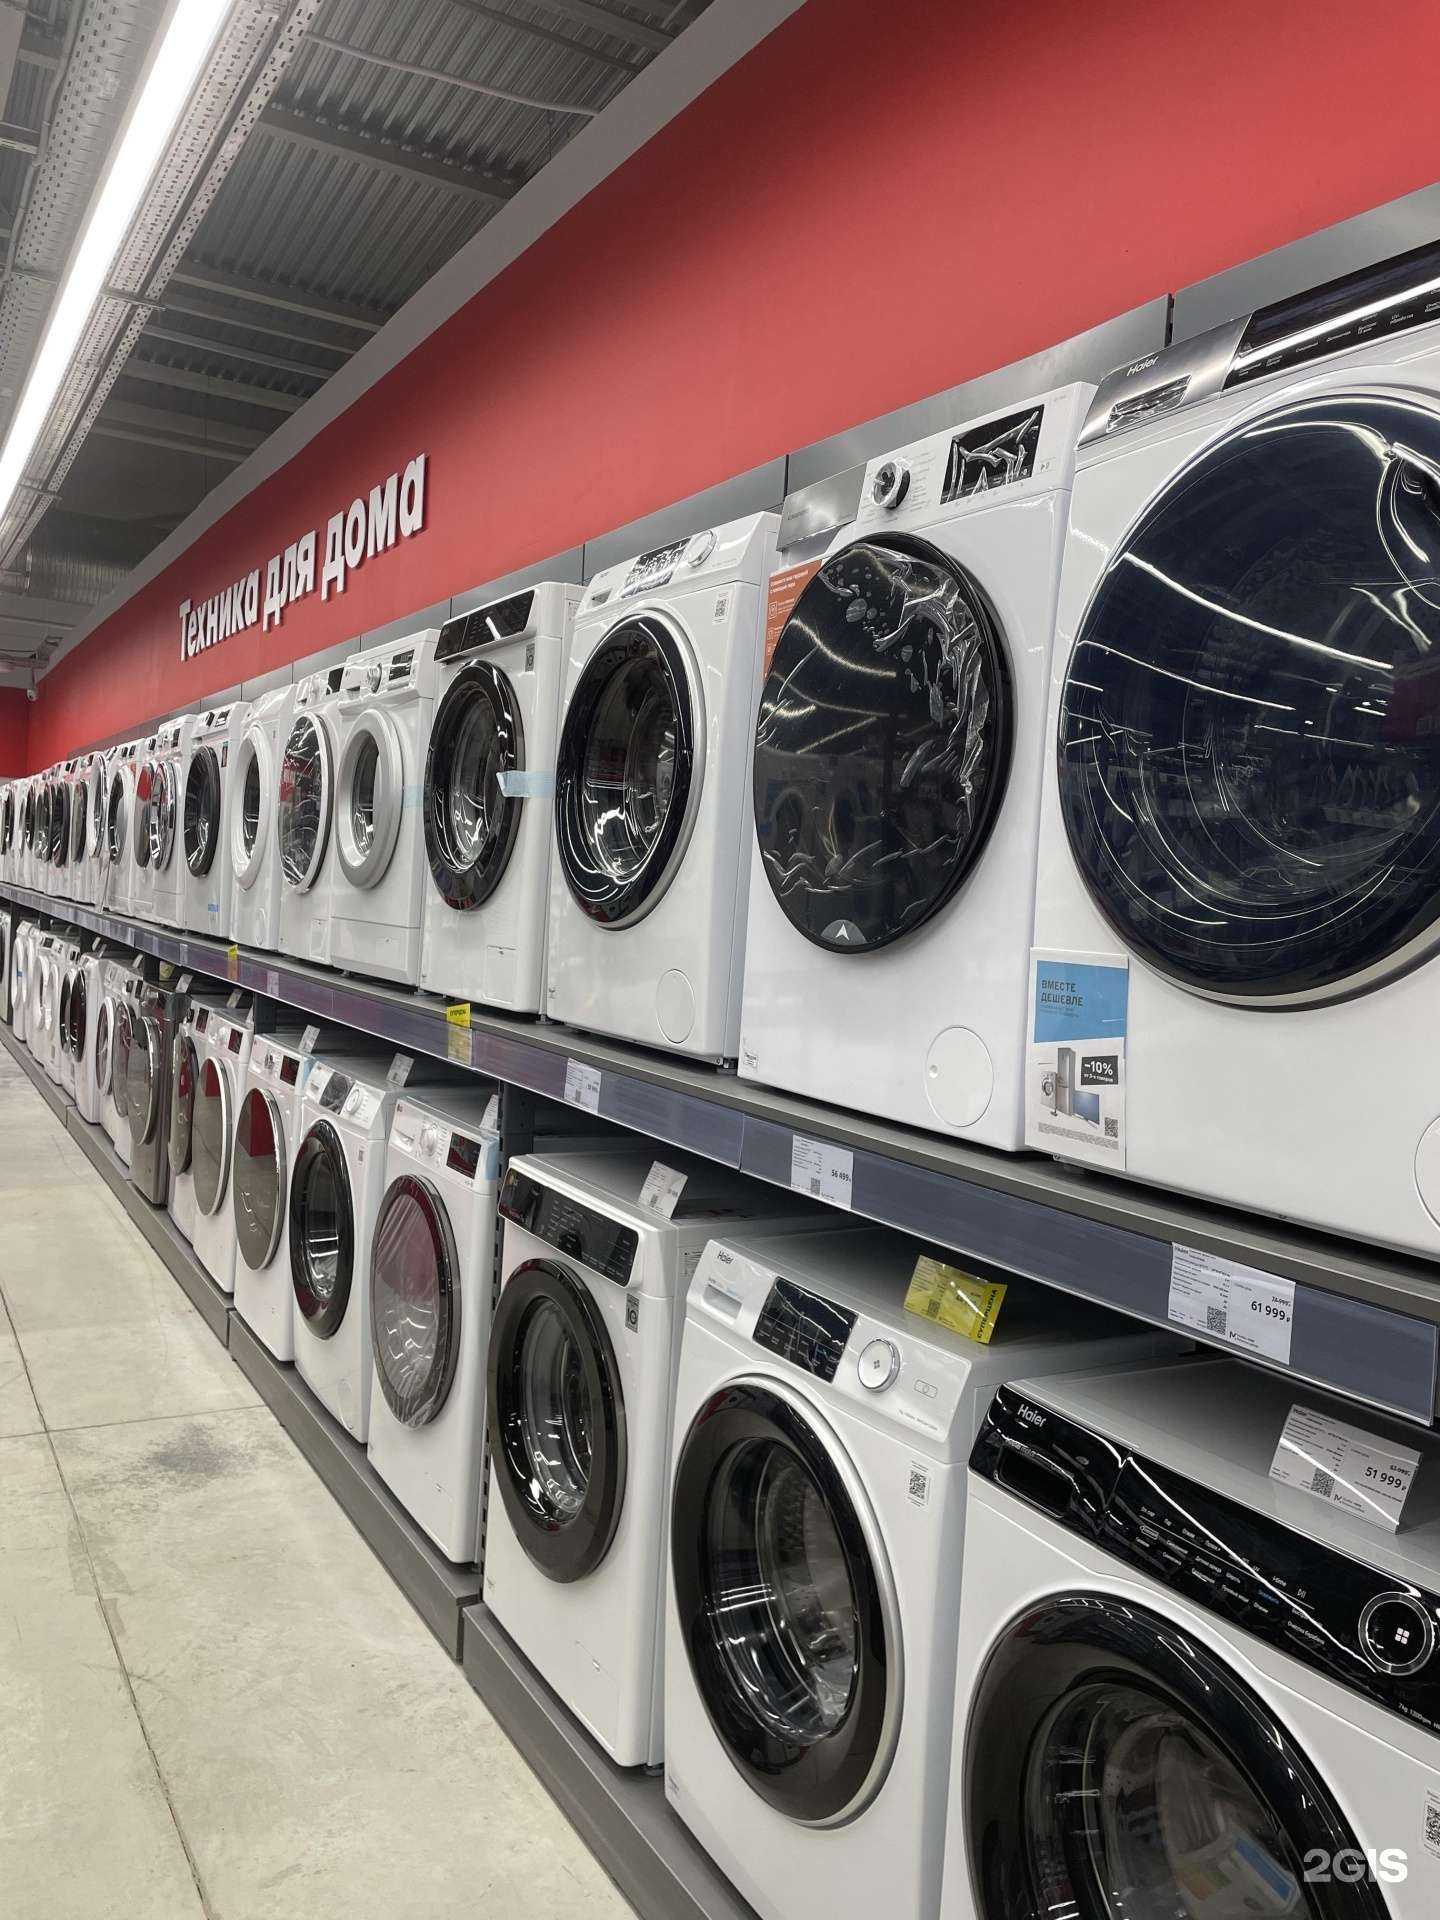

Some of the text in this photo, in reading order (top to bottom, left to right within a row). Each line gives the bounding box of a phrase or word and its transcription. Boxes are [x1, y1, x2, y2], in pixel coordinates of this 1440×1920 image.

[1126, 356, 1159, 376] Haier
[178, 453, 426, 662] Техника для дома
[1041, 980, 1076, 993] ВМЕСТЕ
[1041, 992, 1084, 1007] ДЕШЕВЛЕ
[1251, 1300, 1262, 1312] 61
[1018, 1403, 1047, 1427] Haier
[1365, 1466, 1377, 1478] 51
